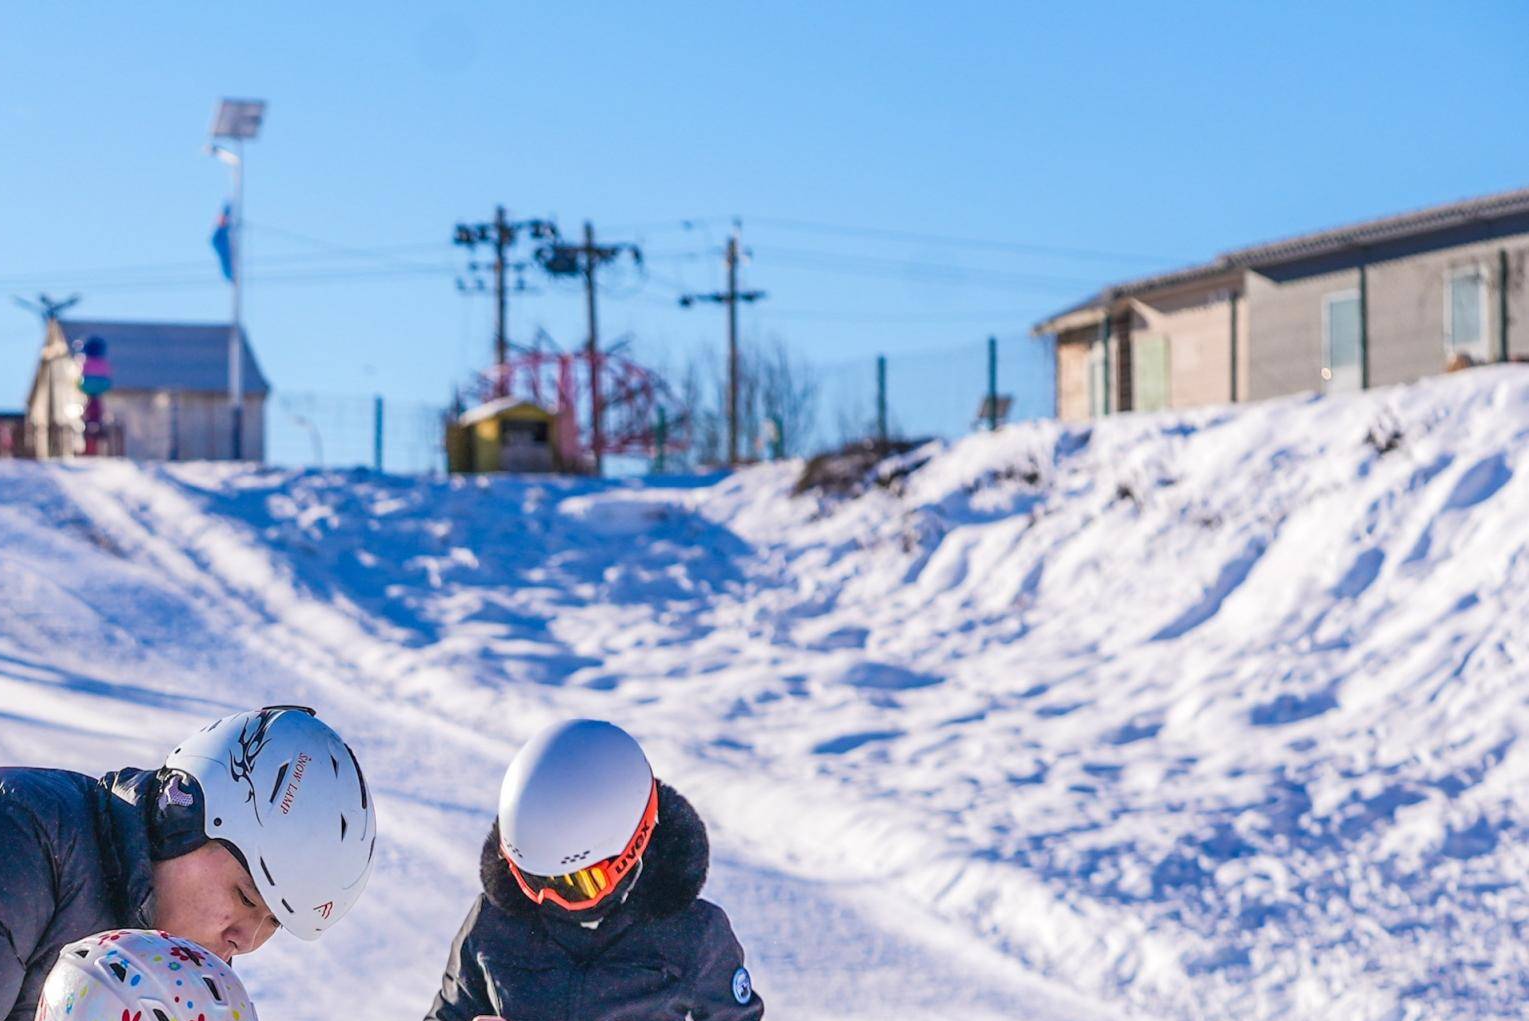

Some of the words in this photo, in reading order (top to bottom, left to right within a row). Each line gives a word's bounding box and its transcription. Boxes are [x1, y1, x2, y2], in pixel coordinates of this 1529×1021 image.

[293, 752, 309, 782] SNOW
[281, 783, 298, 814] LAMP
[616, 821, 649, 873] uvex
